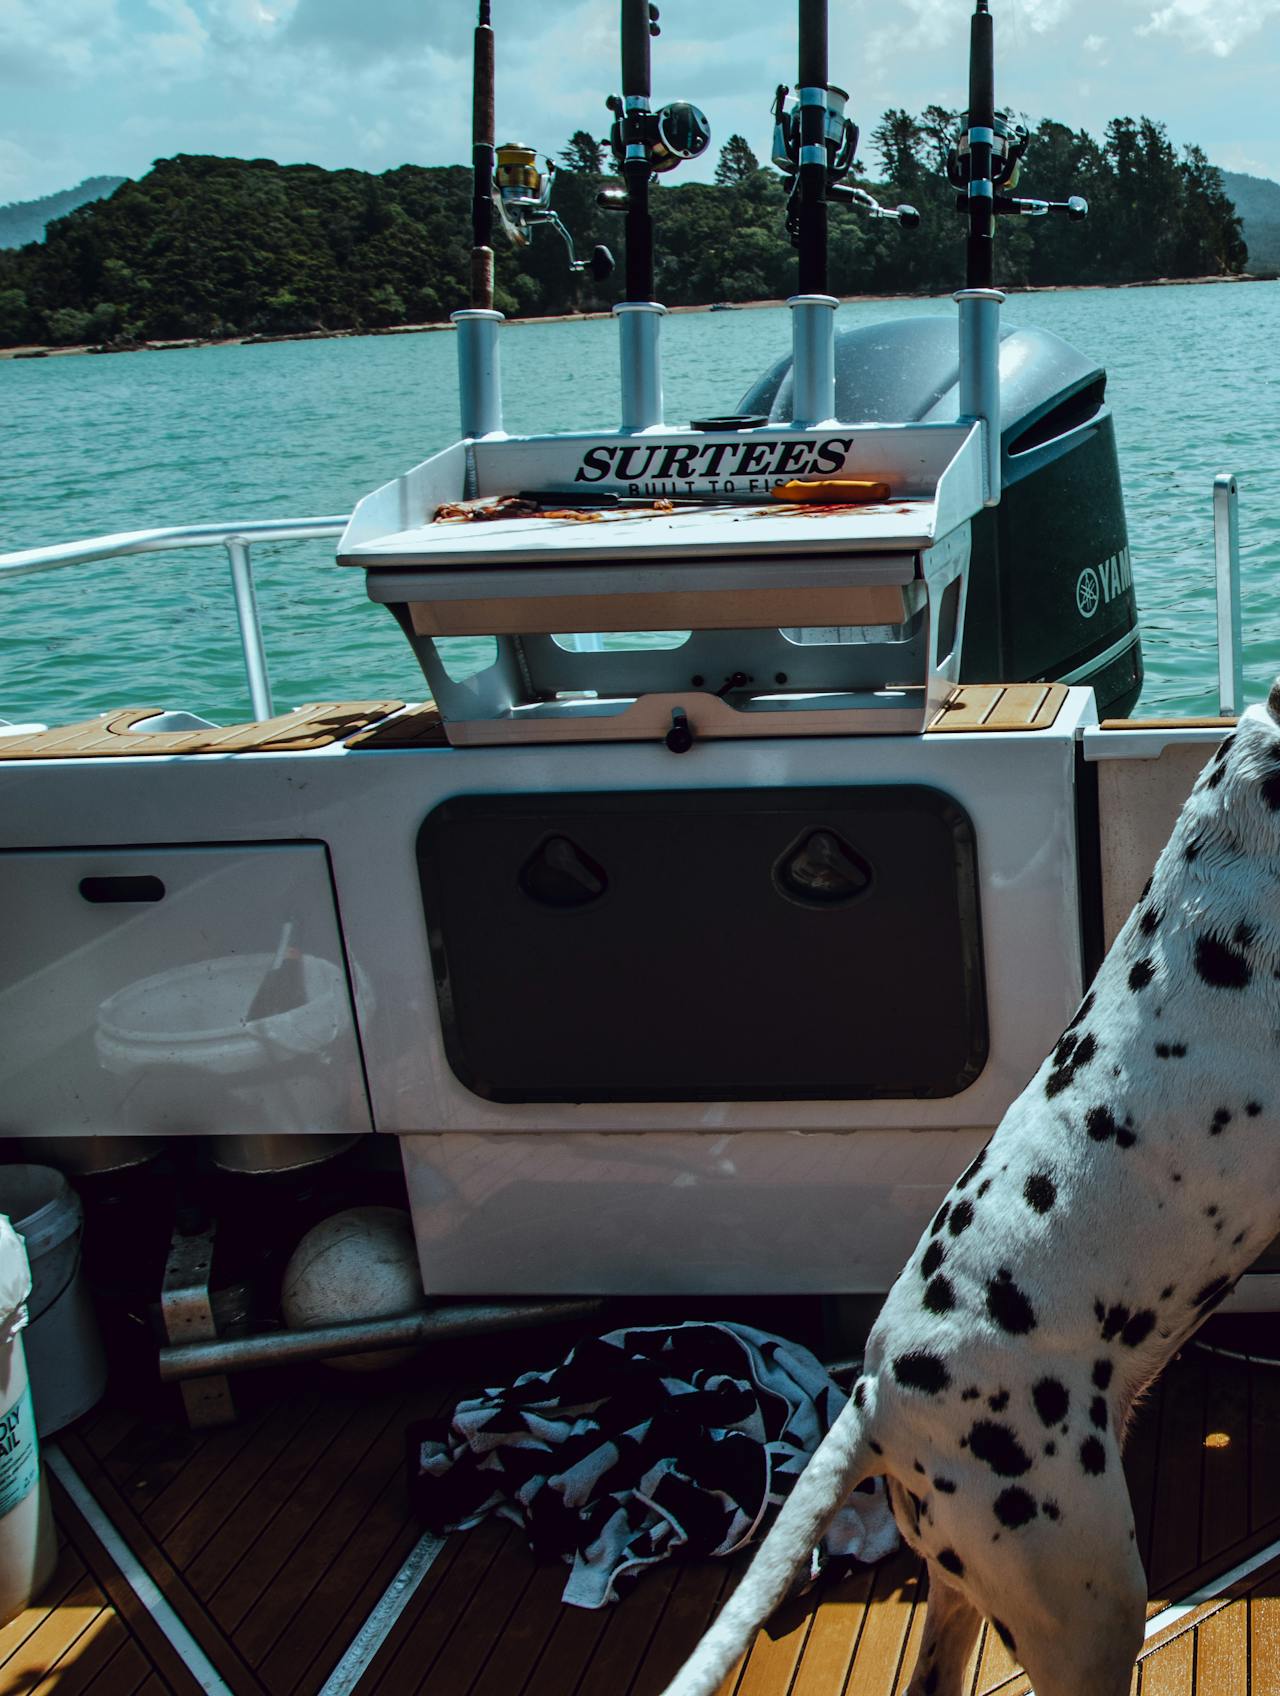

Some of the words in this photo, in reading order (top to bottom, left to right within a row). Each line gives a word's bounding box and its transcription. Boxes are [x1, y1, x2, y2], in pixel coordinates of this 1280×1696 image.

[574, 438, 854, 482] SURTEES
[708, 479, 735, 494] TO
[749, 478, 801, 493] FIS
